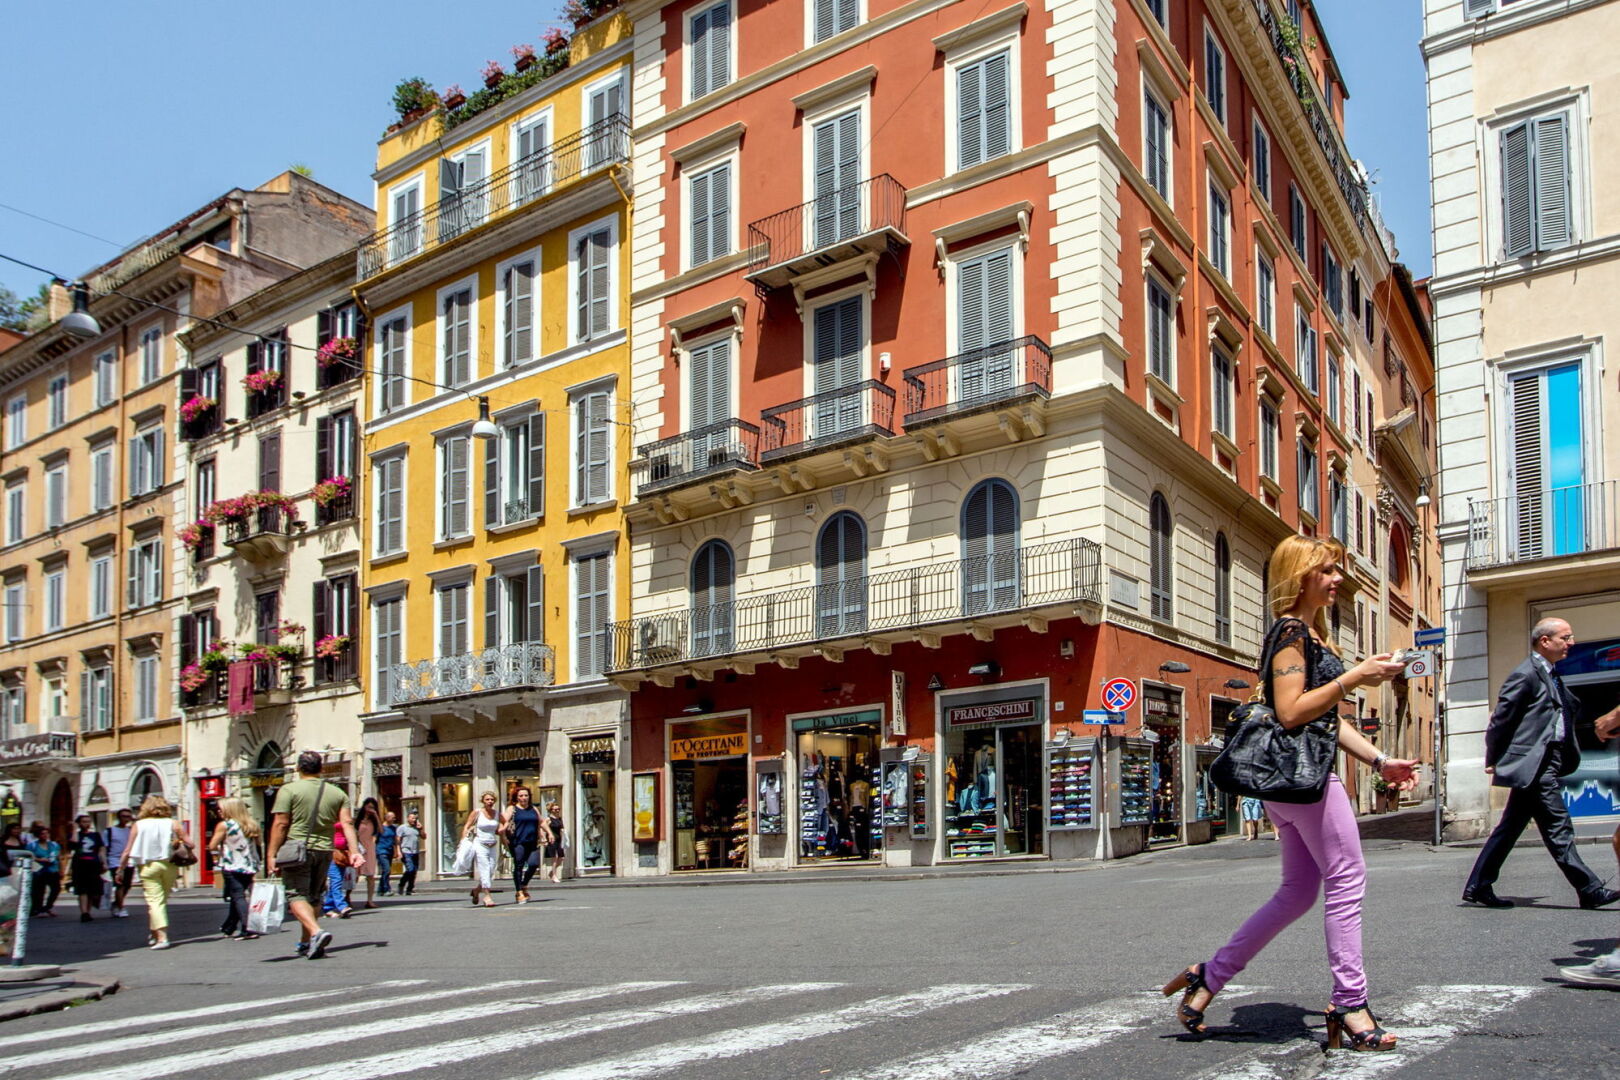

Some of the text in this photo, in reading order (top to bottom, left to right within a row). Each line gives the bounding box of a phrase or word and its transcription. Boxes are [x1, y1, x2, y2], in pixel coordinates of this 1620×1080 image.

[953, 702, 1030, 721] FRANCESCHINI
[812, 714, 858, 728] Da Vinci
[570, 738, 616, 755] SIMONA
[673, 735, 744, 754] L'OCCITANE
[431, 753, 473, 769] SIMONA
[495, 746, 541, 763] SIMONA
